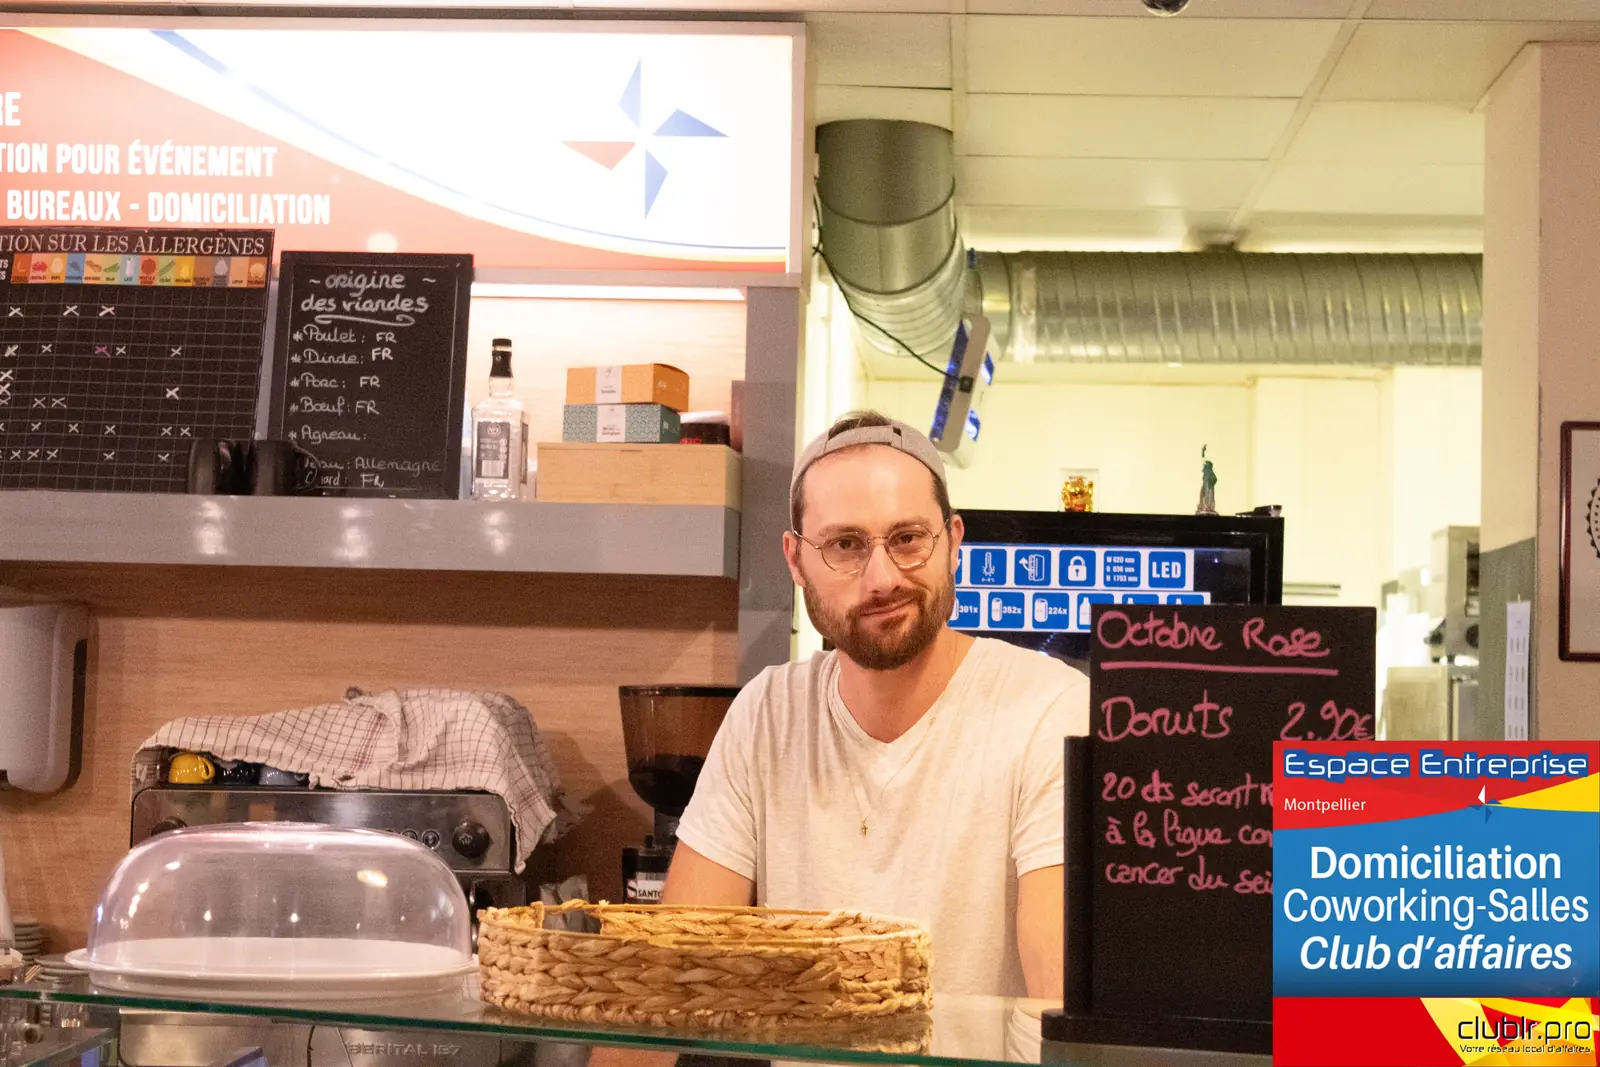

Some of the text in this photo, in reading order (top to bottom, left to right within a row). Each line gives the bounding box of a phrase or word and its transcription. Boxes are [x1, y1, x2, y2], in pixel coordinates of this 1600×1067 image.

[0, 92, 21, 126] E
[56, 143, 119, 174] POUR
[128, 139, 277, 177] ÉVÉNEMENT
[7, 190, 121, 222] BUREAUX
[148, 191, 330, 224] DOMICILIATION
[48, 234, 87, 252] SUR
[92, 235, 128, 253] LES
[132, 233, 265, 255] ALLERGÈNES
[301, 294, 429, 313] des viandes
[376, 332, 397, 344] FR
[372, 348, 393, 361] FR
[360, 376, 380, 388] FR
[356, 400, 379, 415] FR
[355, 457, 442, 478] Allemagne
[1152, 561, 1181, 579] LED
[1048, 607, 1067, 615] 224x
[1097, 610, 1330, 658] Octobre Rose
[1097, 689, 1374, 742] Donuts 2.90€
[1101, 772, 1135, 801] 20
[1104, 817, 1126, 845] à
[1133, 811, 1156, 848] la
[1163, 809, 1232, 857] ligue
[1105, 855, 1273, 894] cancer du sei
